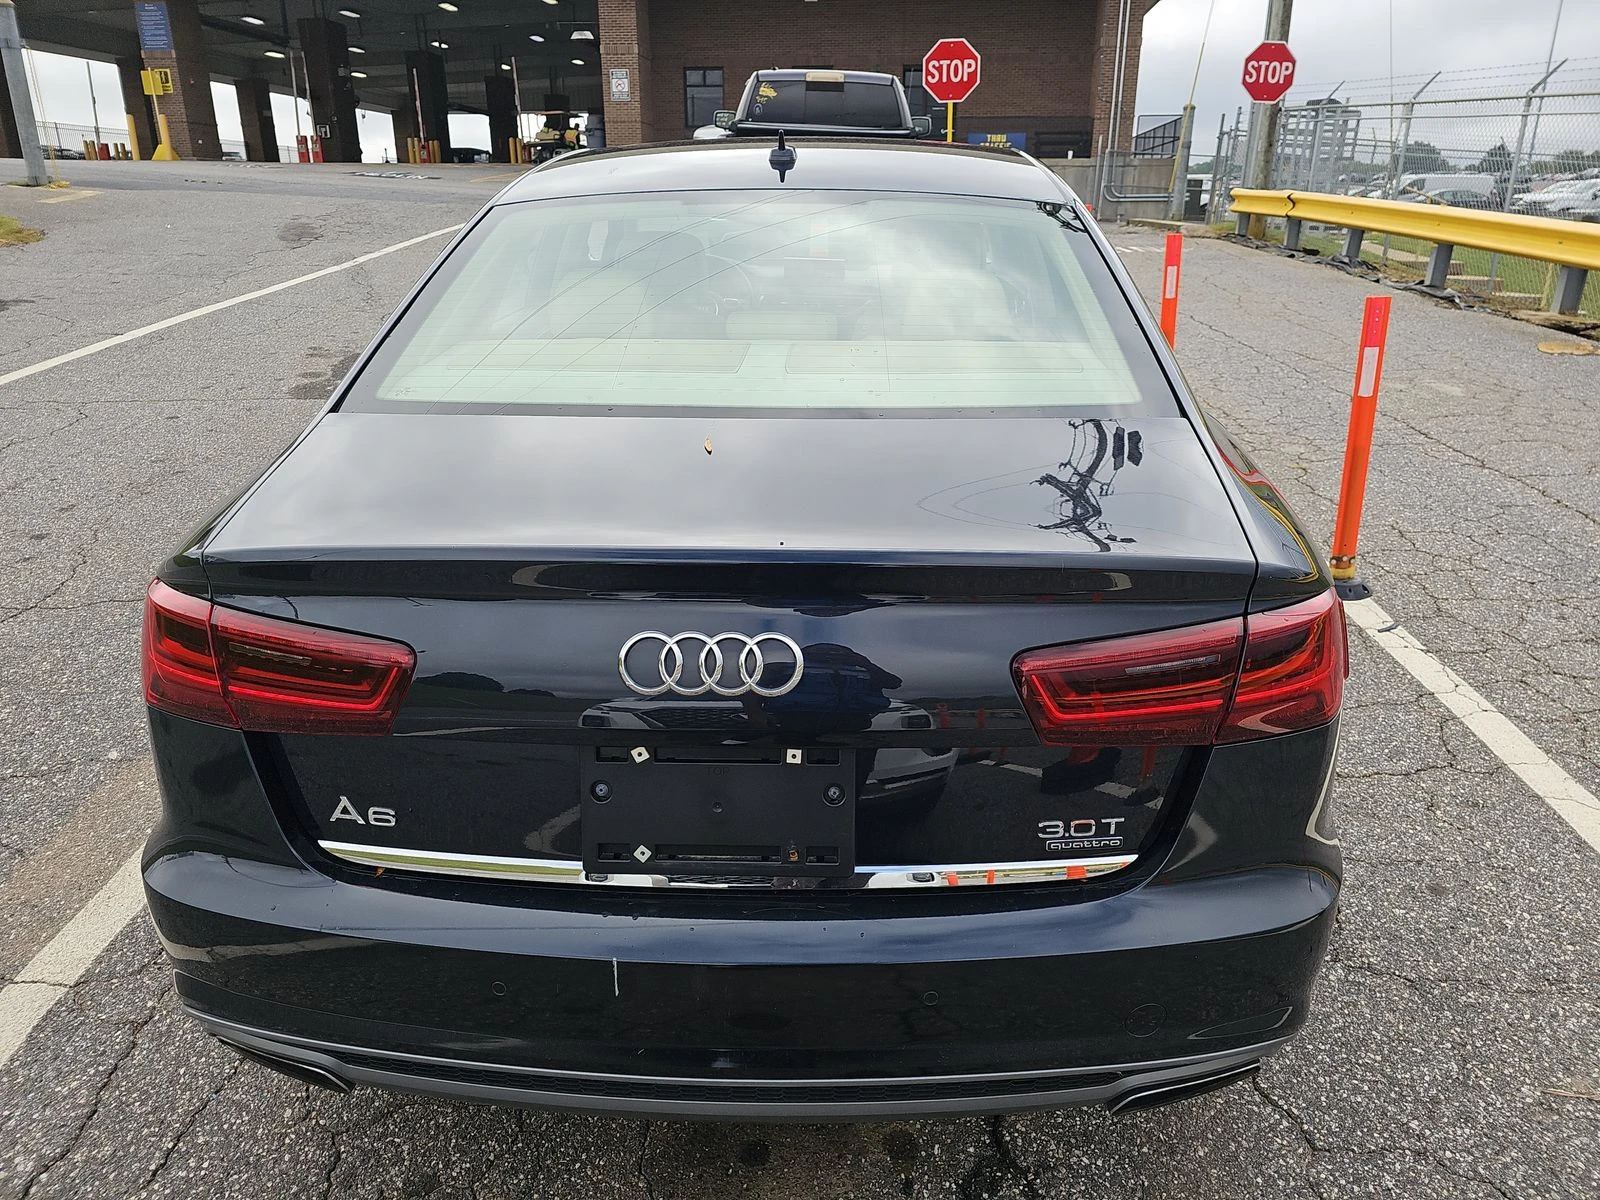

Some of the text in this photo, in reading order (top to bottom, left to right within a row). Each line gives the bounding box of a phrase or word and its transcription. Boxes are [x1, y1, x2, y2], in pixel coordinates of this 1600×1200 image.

[927, 59, 976, 84] STOP
[1245, 60, 1294, 84] STOP
[329, 795, 396, 827] A6
[1050, 840, 1120, 850] quattro
